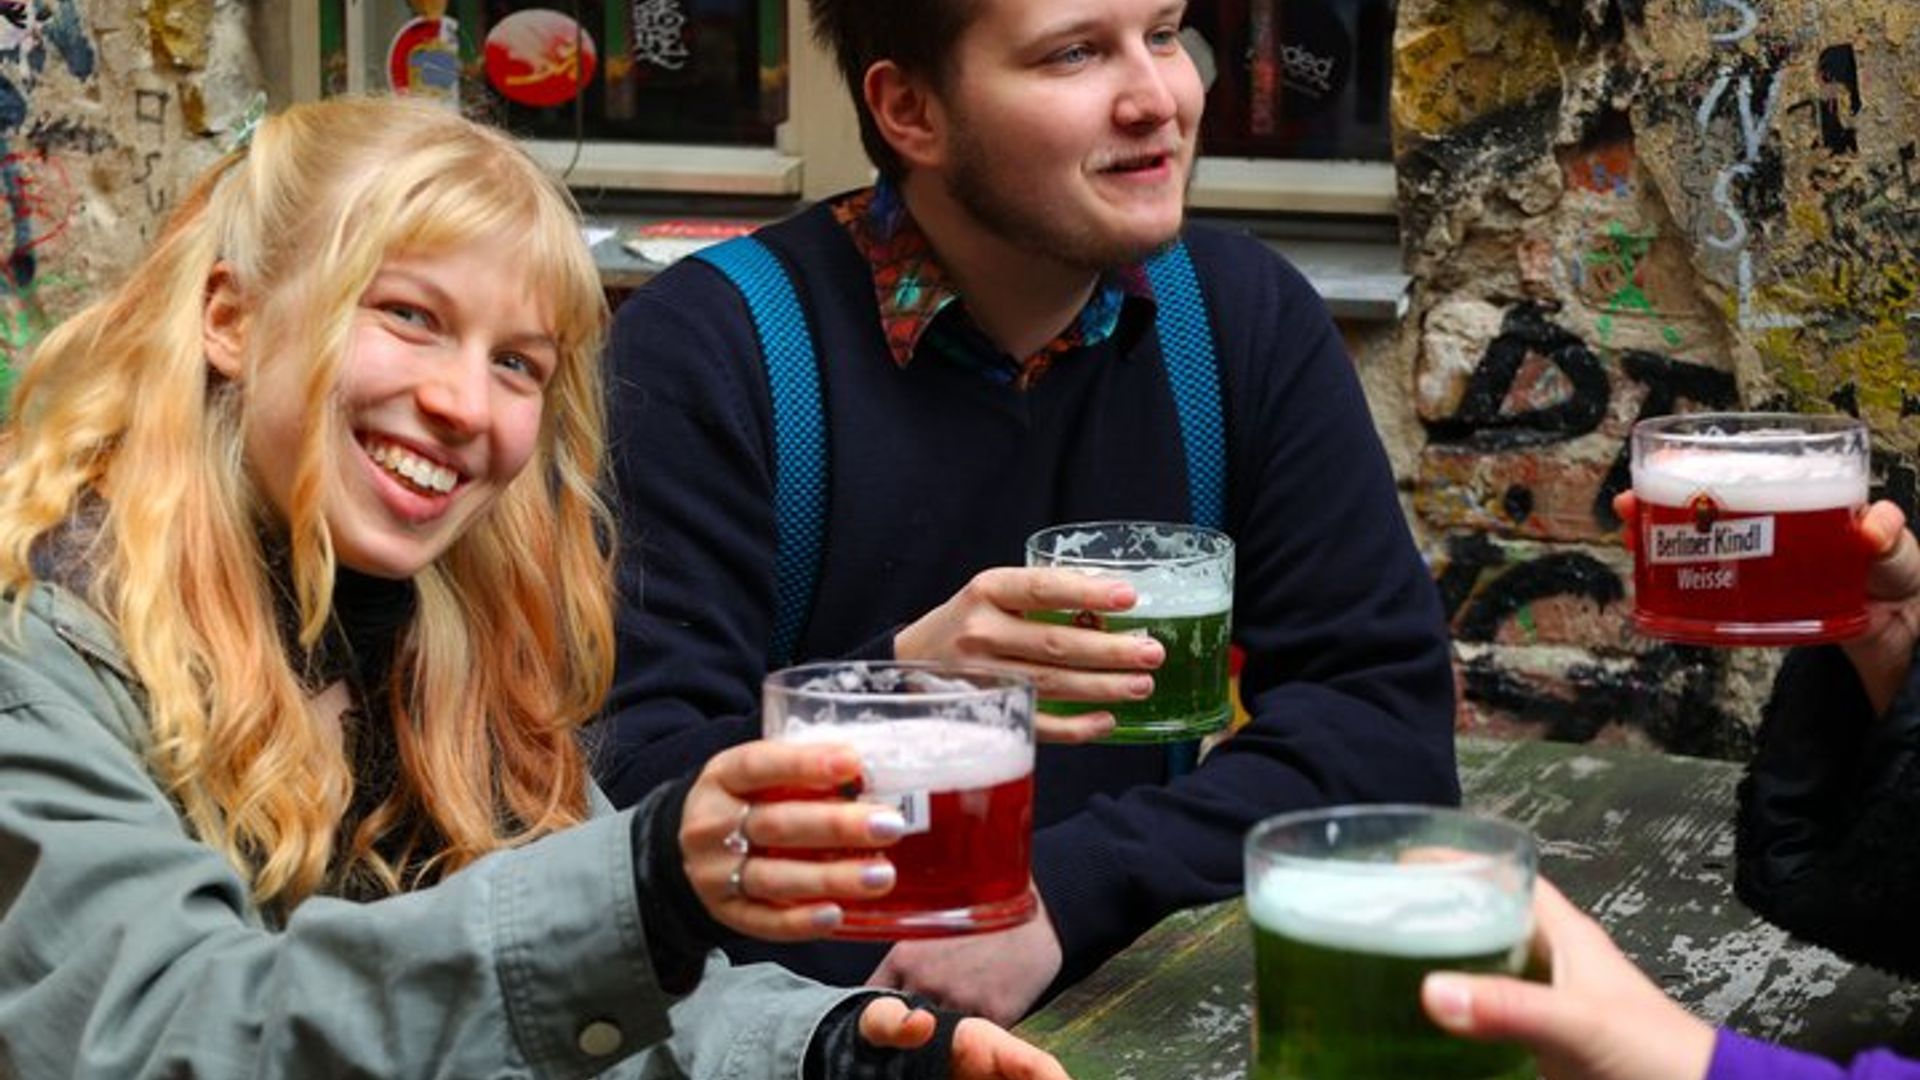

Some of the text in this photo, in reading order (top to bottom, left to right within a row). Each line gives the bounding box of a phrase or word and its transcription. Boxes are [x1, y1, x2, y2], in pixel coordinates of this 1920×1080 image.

[1656, 523, 1761, 557] Berliner Kindl
[1677, 566, 1734, 590] Weisse
